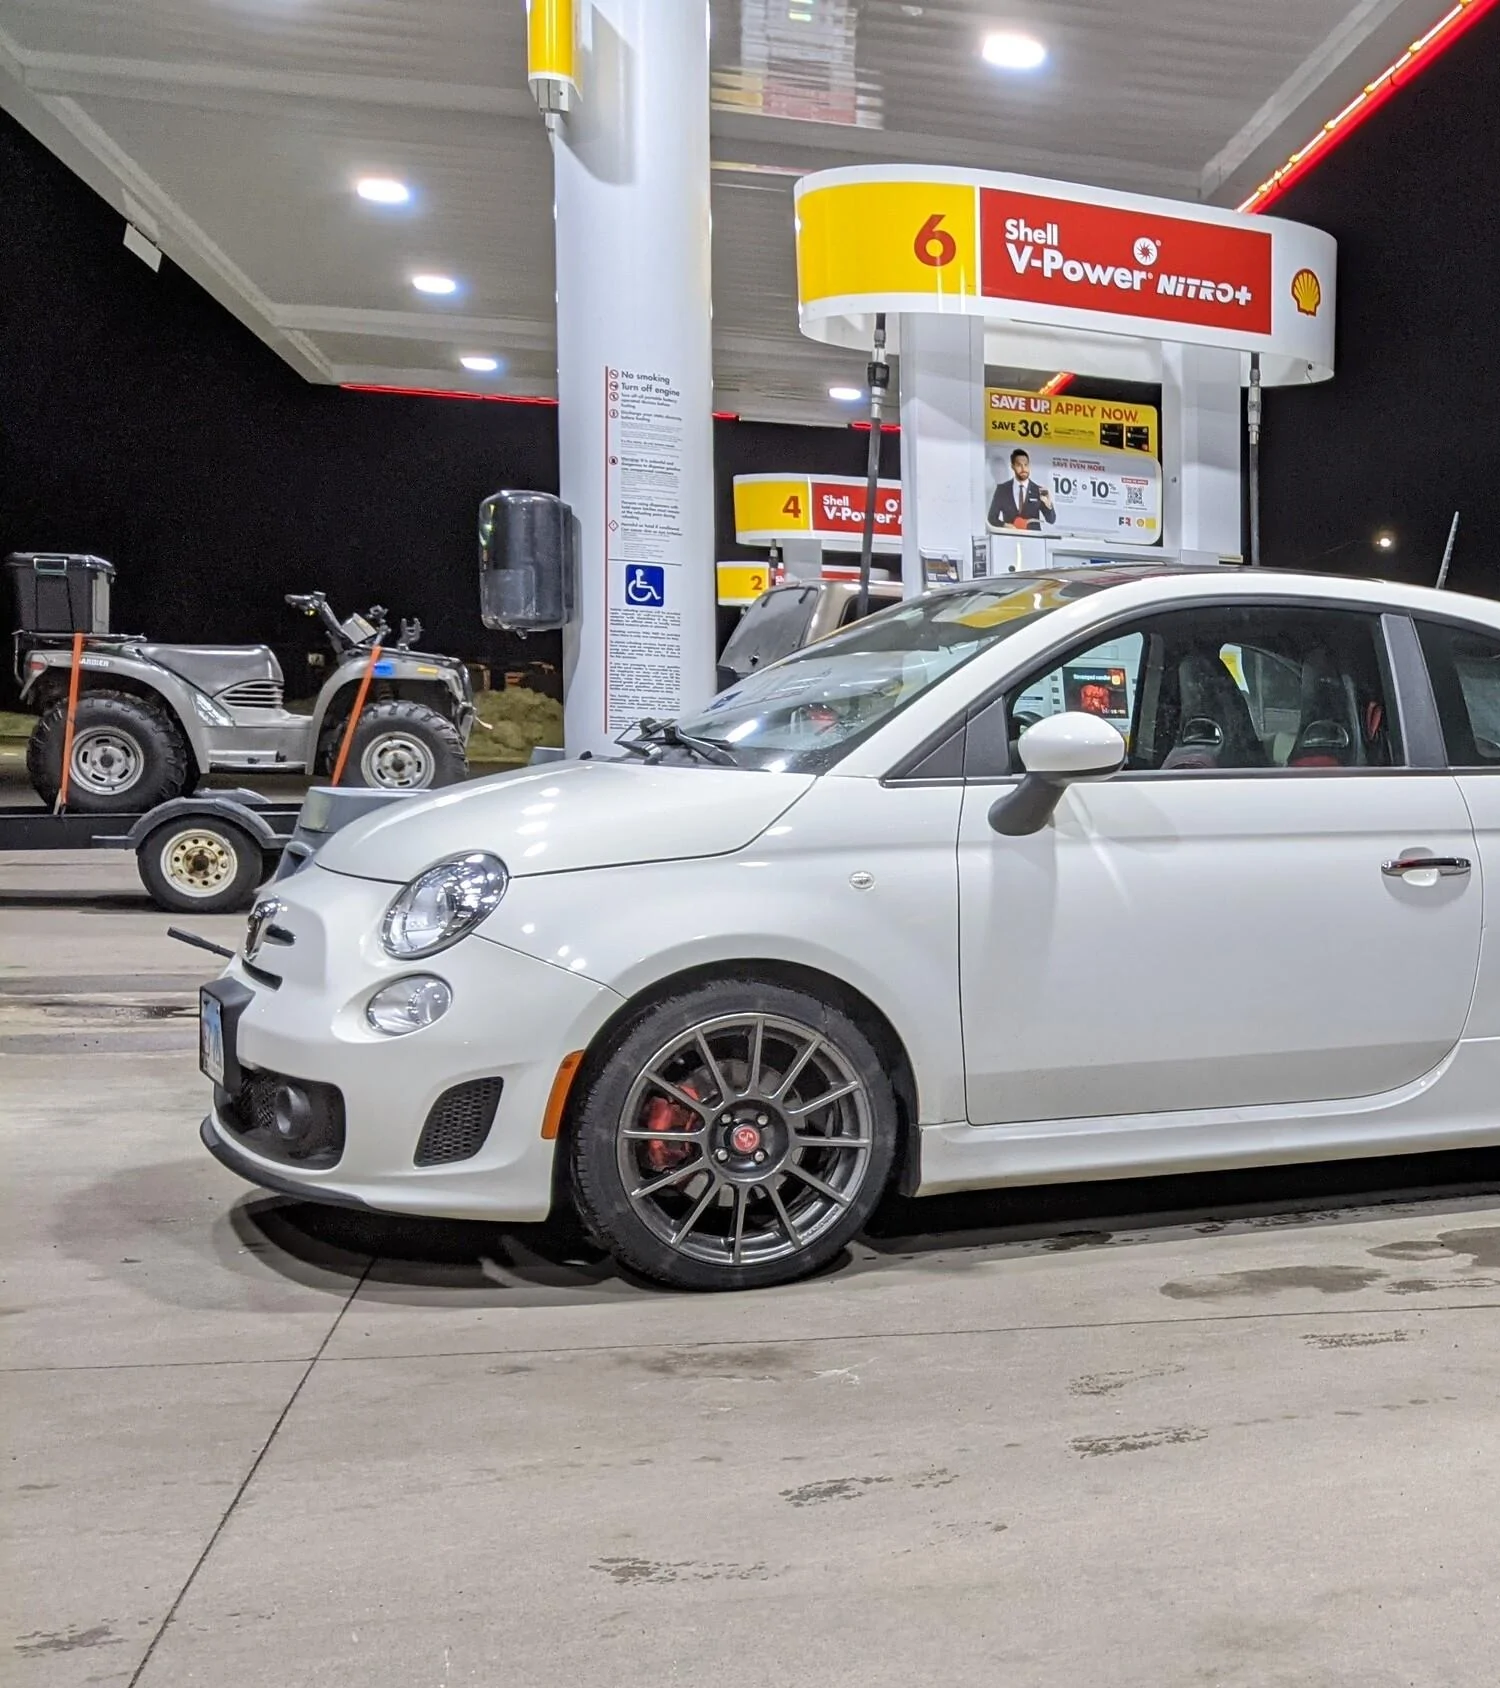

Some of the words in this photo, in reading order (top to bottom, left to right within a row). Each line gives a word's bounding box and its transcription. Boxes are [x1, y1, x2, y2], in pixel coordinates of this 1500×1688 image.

[913, 214, 957, 267] 6
[1004, 218, 1059, 246] Shell
[1005, 242, 1149, 291] V-Power
[621, 370, 634, 379] No
[636, 373, 670, 385] smoking
[621, 382, 639, 391] Turn
[640, 384, 652, 392] off
[655, 387, 680, 397] engine
[991, 394, 1026, 411] SAVE
[1055, 402, 1097, 418] APPLY
[991, 420, 1016, 432] SAVE
[782, 495, 801, 519] 4
[822, 494, 849, 506] Shell
[751, 575, 763, 590] 2
